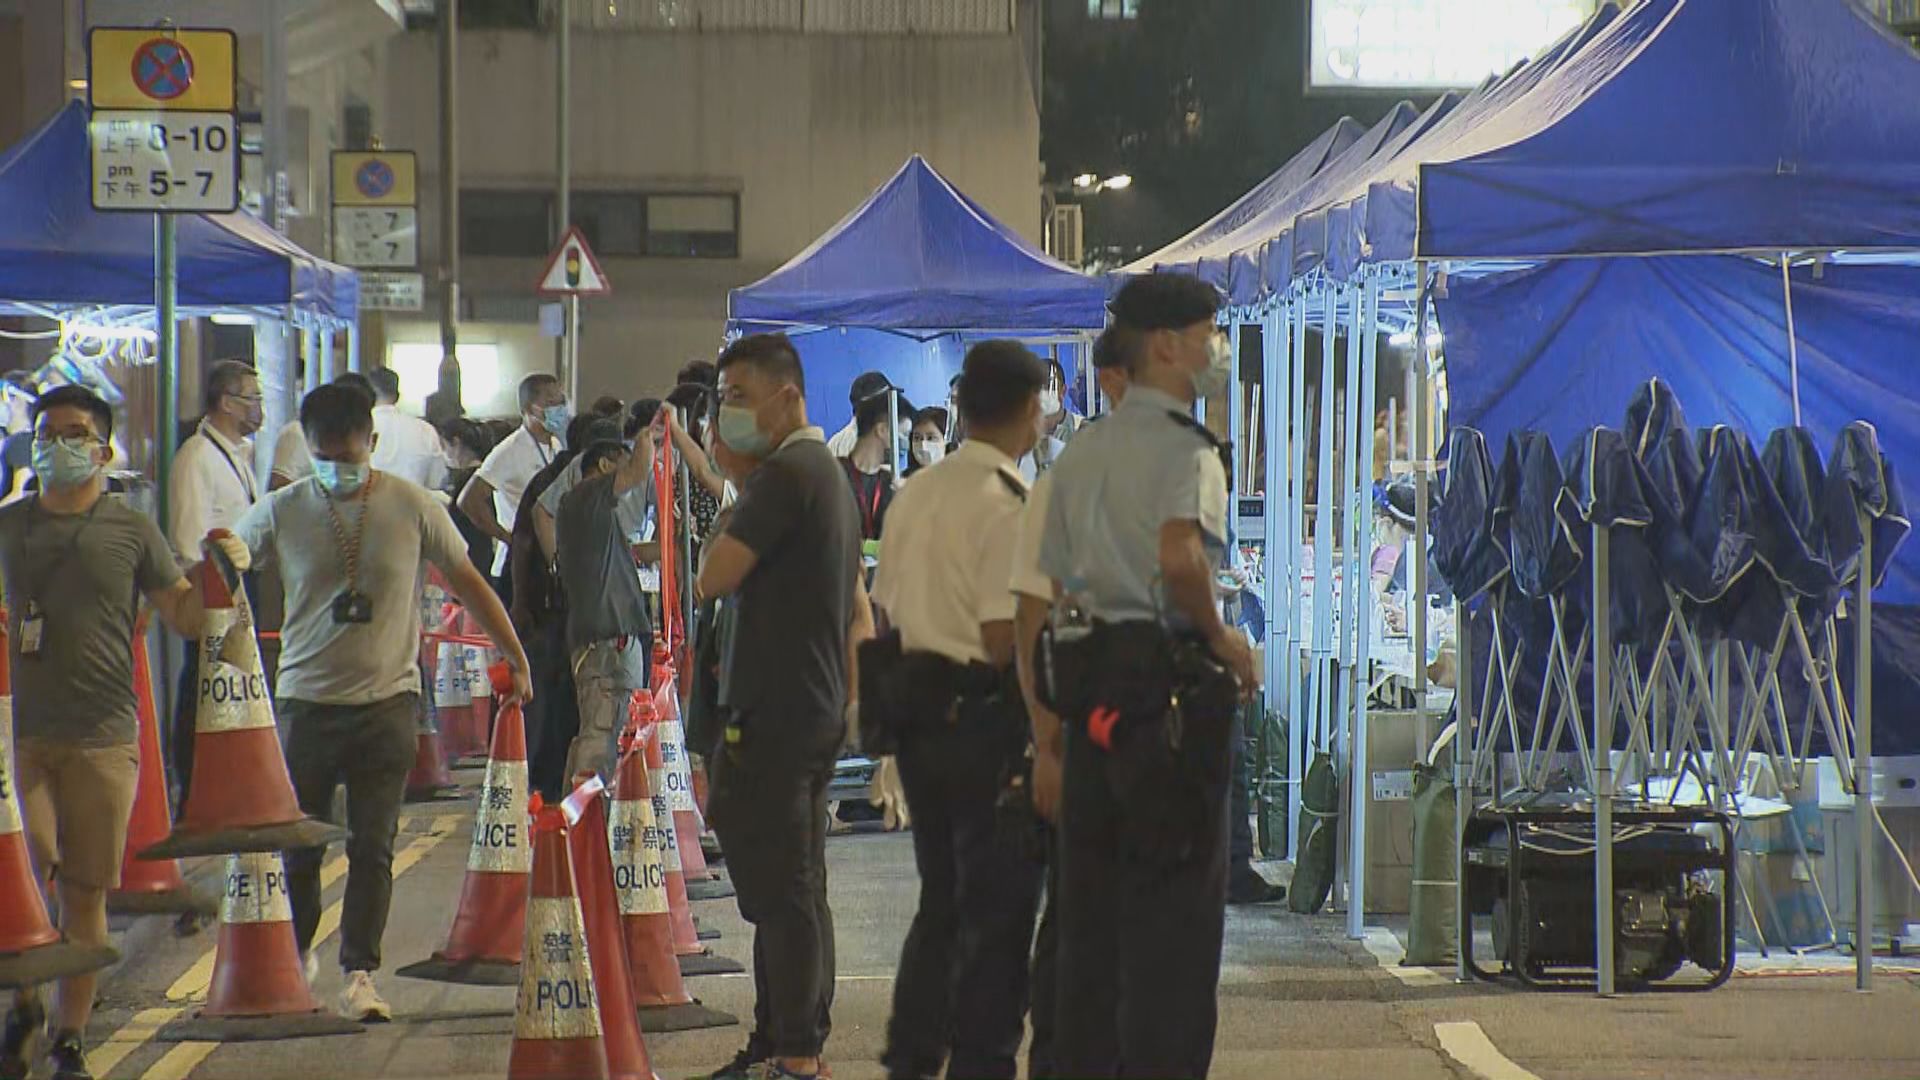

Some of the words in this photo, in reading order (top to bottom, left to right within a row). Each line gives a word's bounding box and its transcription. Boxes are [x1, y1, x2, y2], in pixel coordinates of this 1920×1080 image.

[101, 135, 141, 154] 上午
[108, 165, 133, 178] pm
[101, 181, 142, 199] 下午
